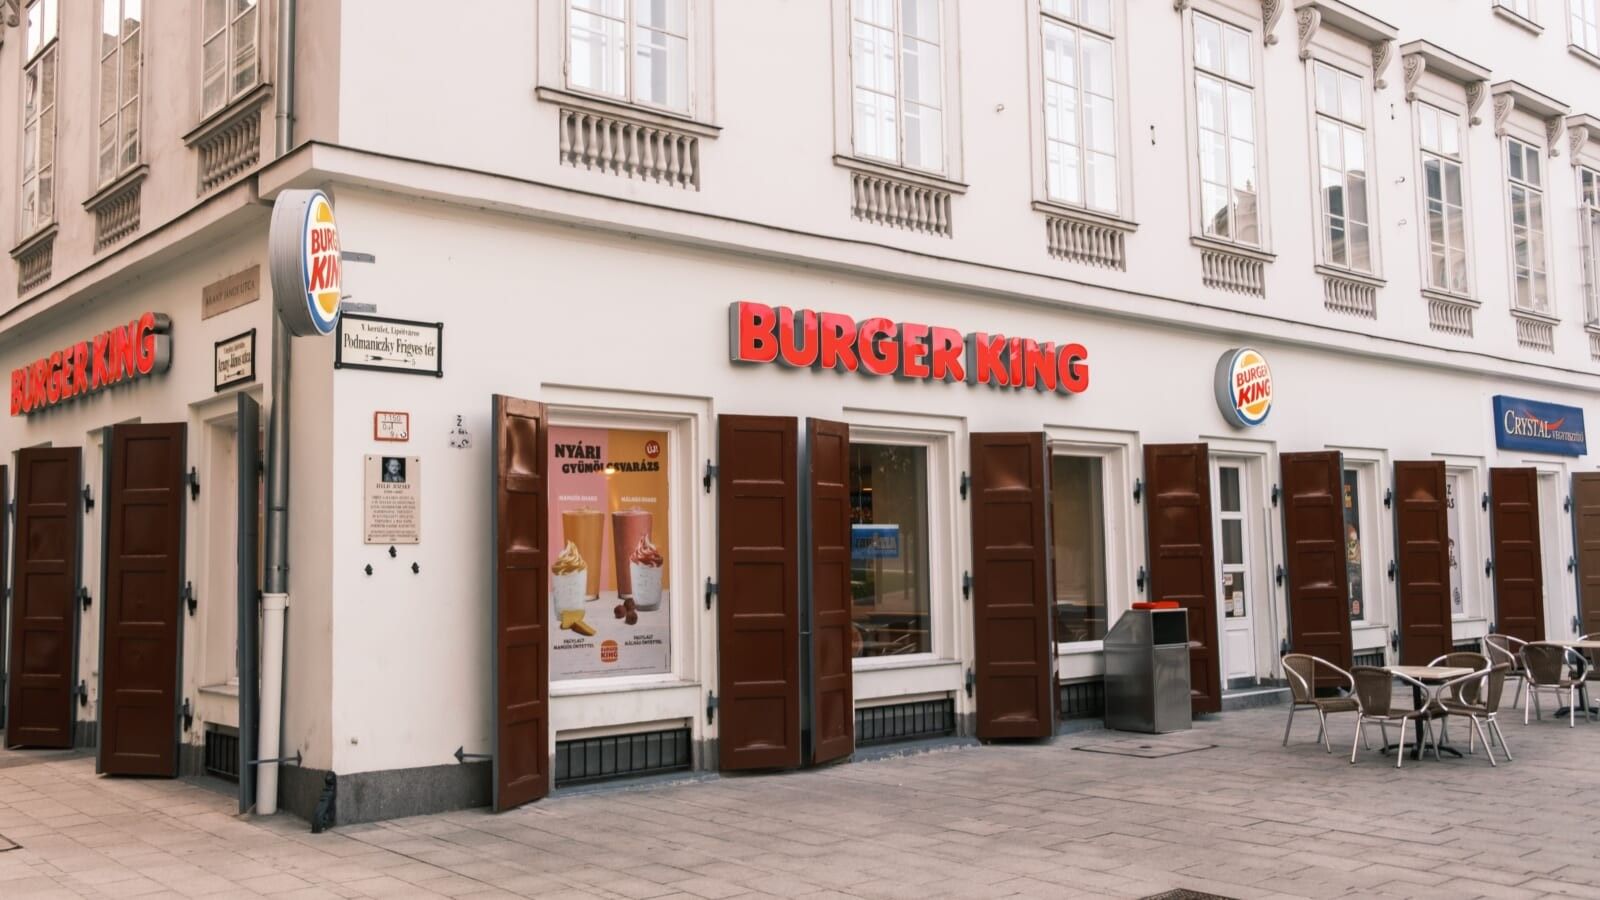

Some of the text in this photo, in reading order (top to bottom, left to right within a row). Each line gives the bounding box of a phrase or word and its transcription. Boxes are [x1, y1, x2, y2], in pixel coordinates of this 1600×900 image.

[311, 228, 338, 254] BURG
[310, 254, 340, 292] KIN
[344, 333, 436, 358] Podmaniczky Frigyes tér
[737, 301, 1089, 394] BURGER KING
[11, 312, 157, 417] BURGER KING
[1238, 379, 1271, 408] KING
[555, 440, 601, 460] NYÁRI
[646, 444, 659, 454] ÚJ!
